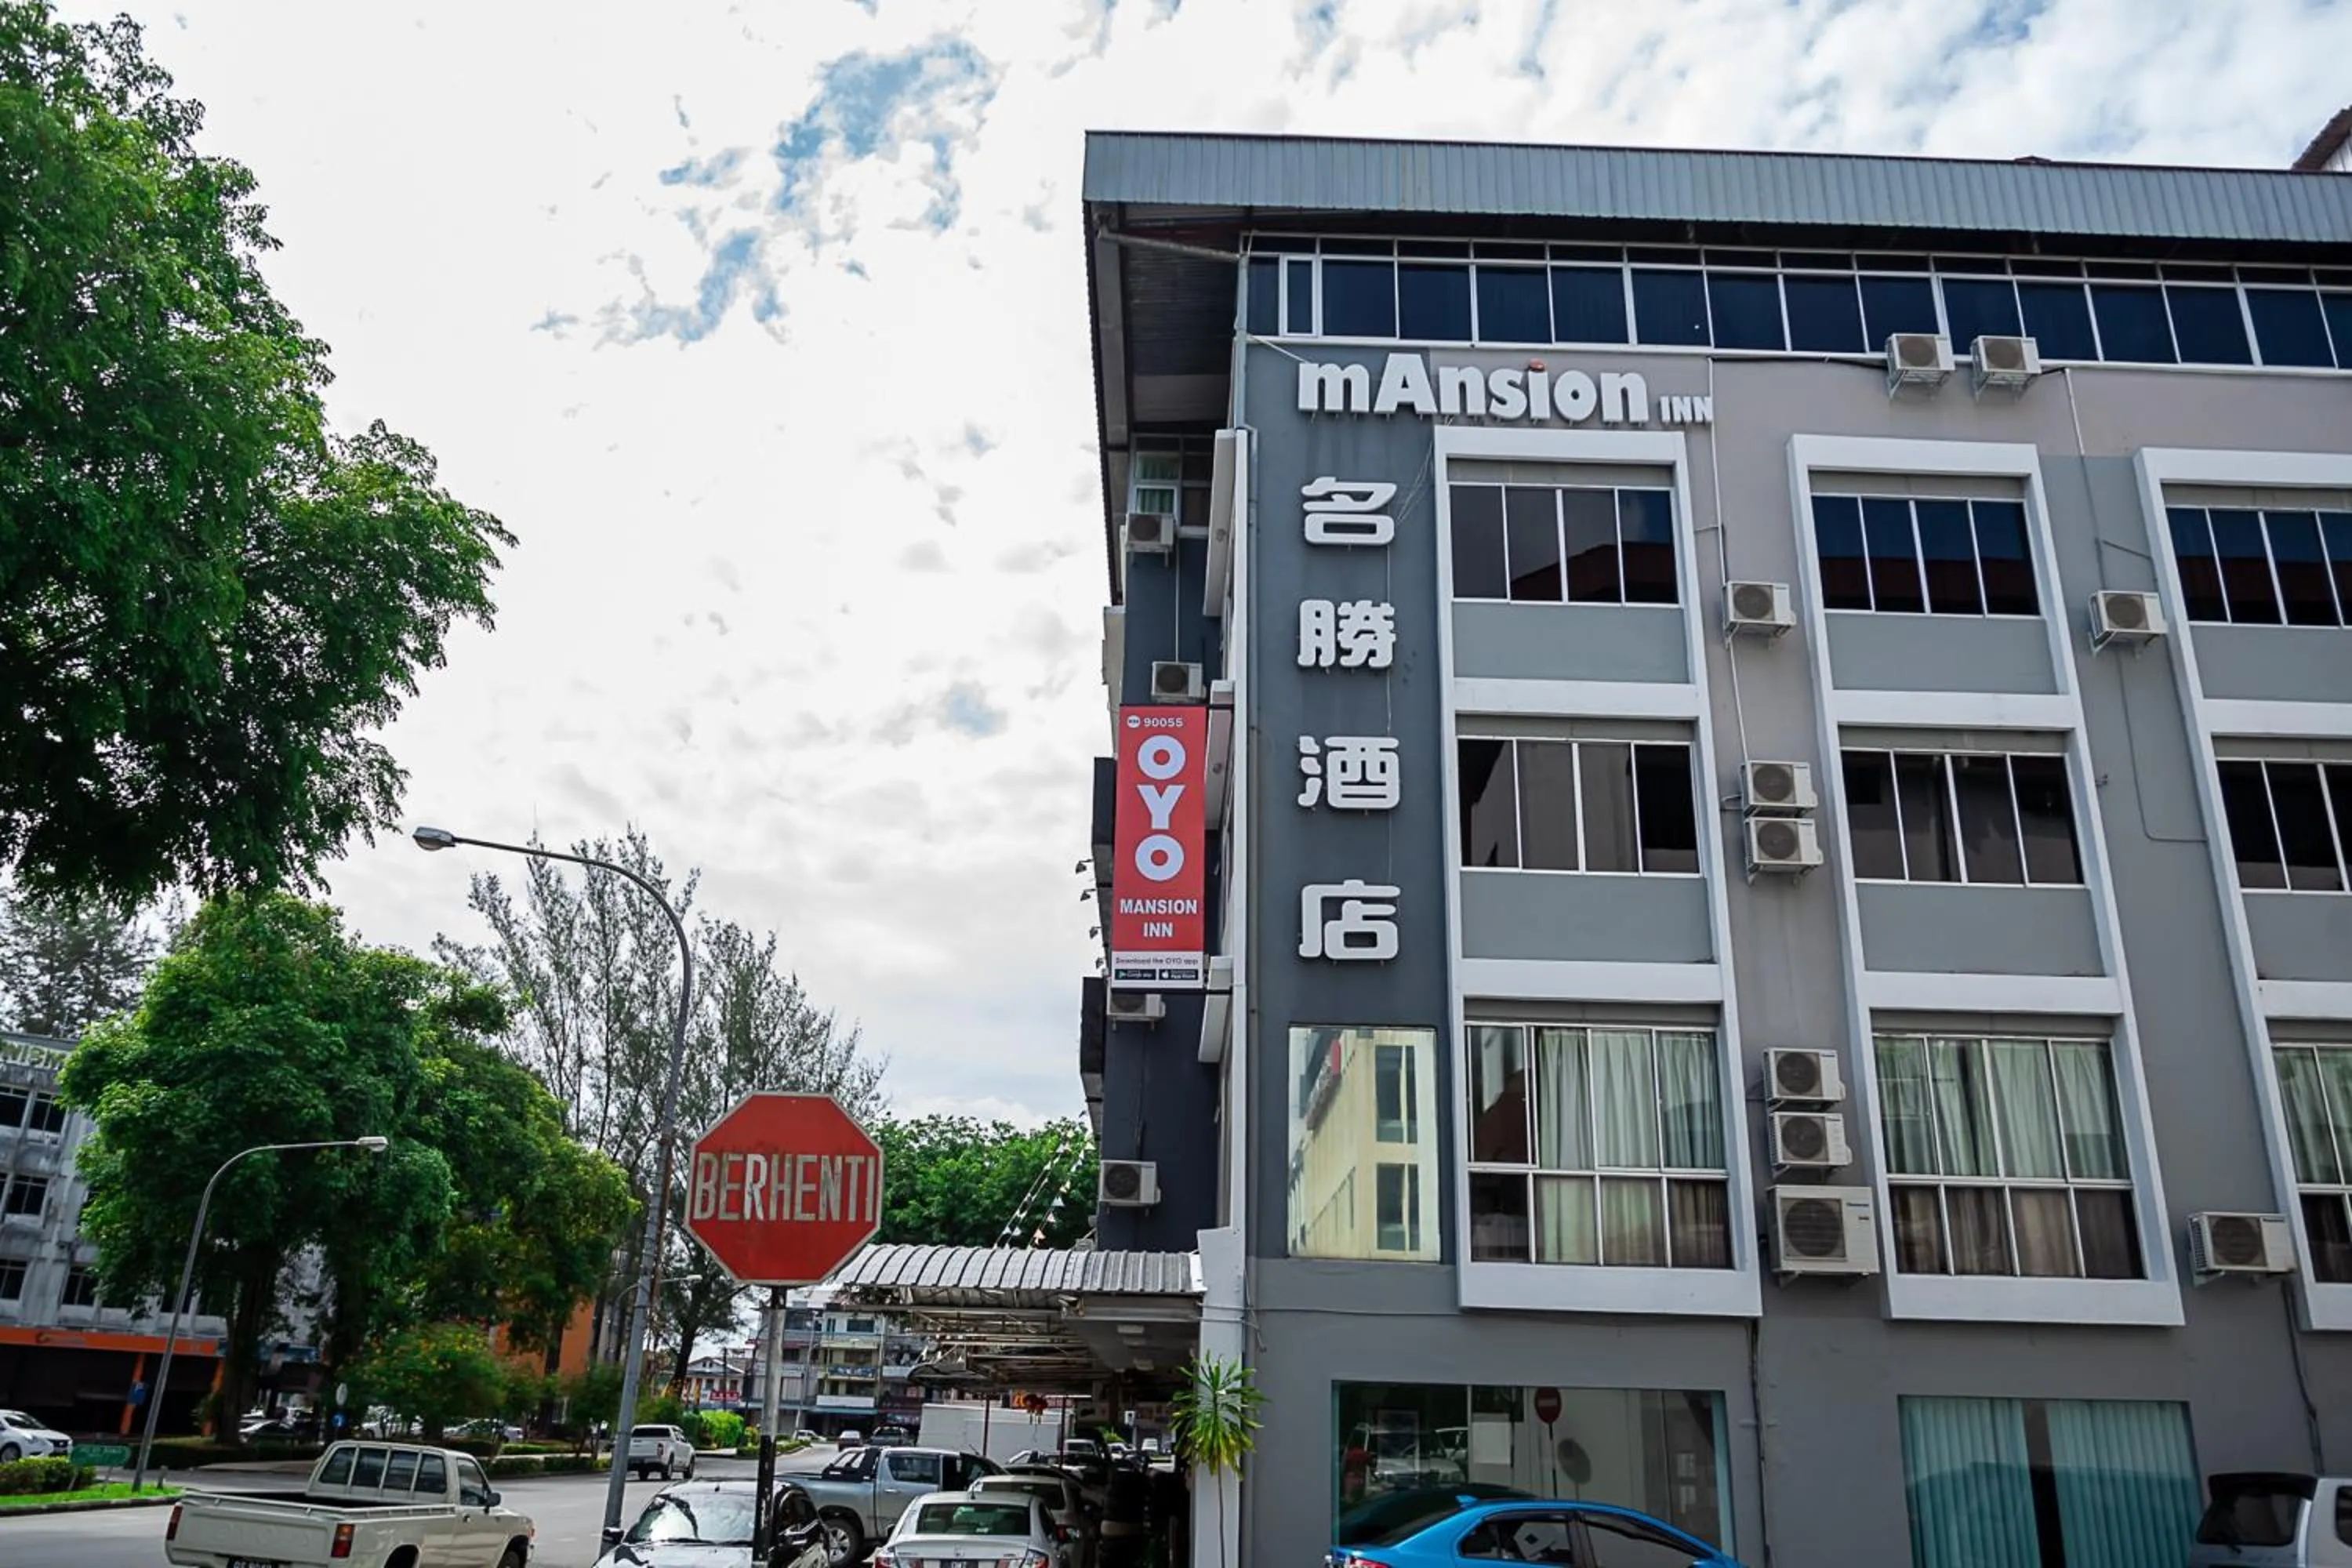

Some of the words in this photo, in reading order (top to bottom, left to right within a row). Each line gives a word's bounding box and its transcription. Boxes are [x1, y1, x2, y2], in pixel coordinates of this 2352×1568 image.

[1659, 395, 1713, 424] INN
[1144, 717, 1183, 727] 90055
[1134, 735, 1186, 880] OYO
[1120, 898, 1197, 914] MANSION
[1143, 922, 1173, 937] INN
[692, 1151, 876, 1222] BERHENTI
